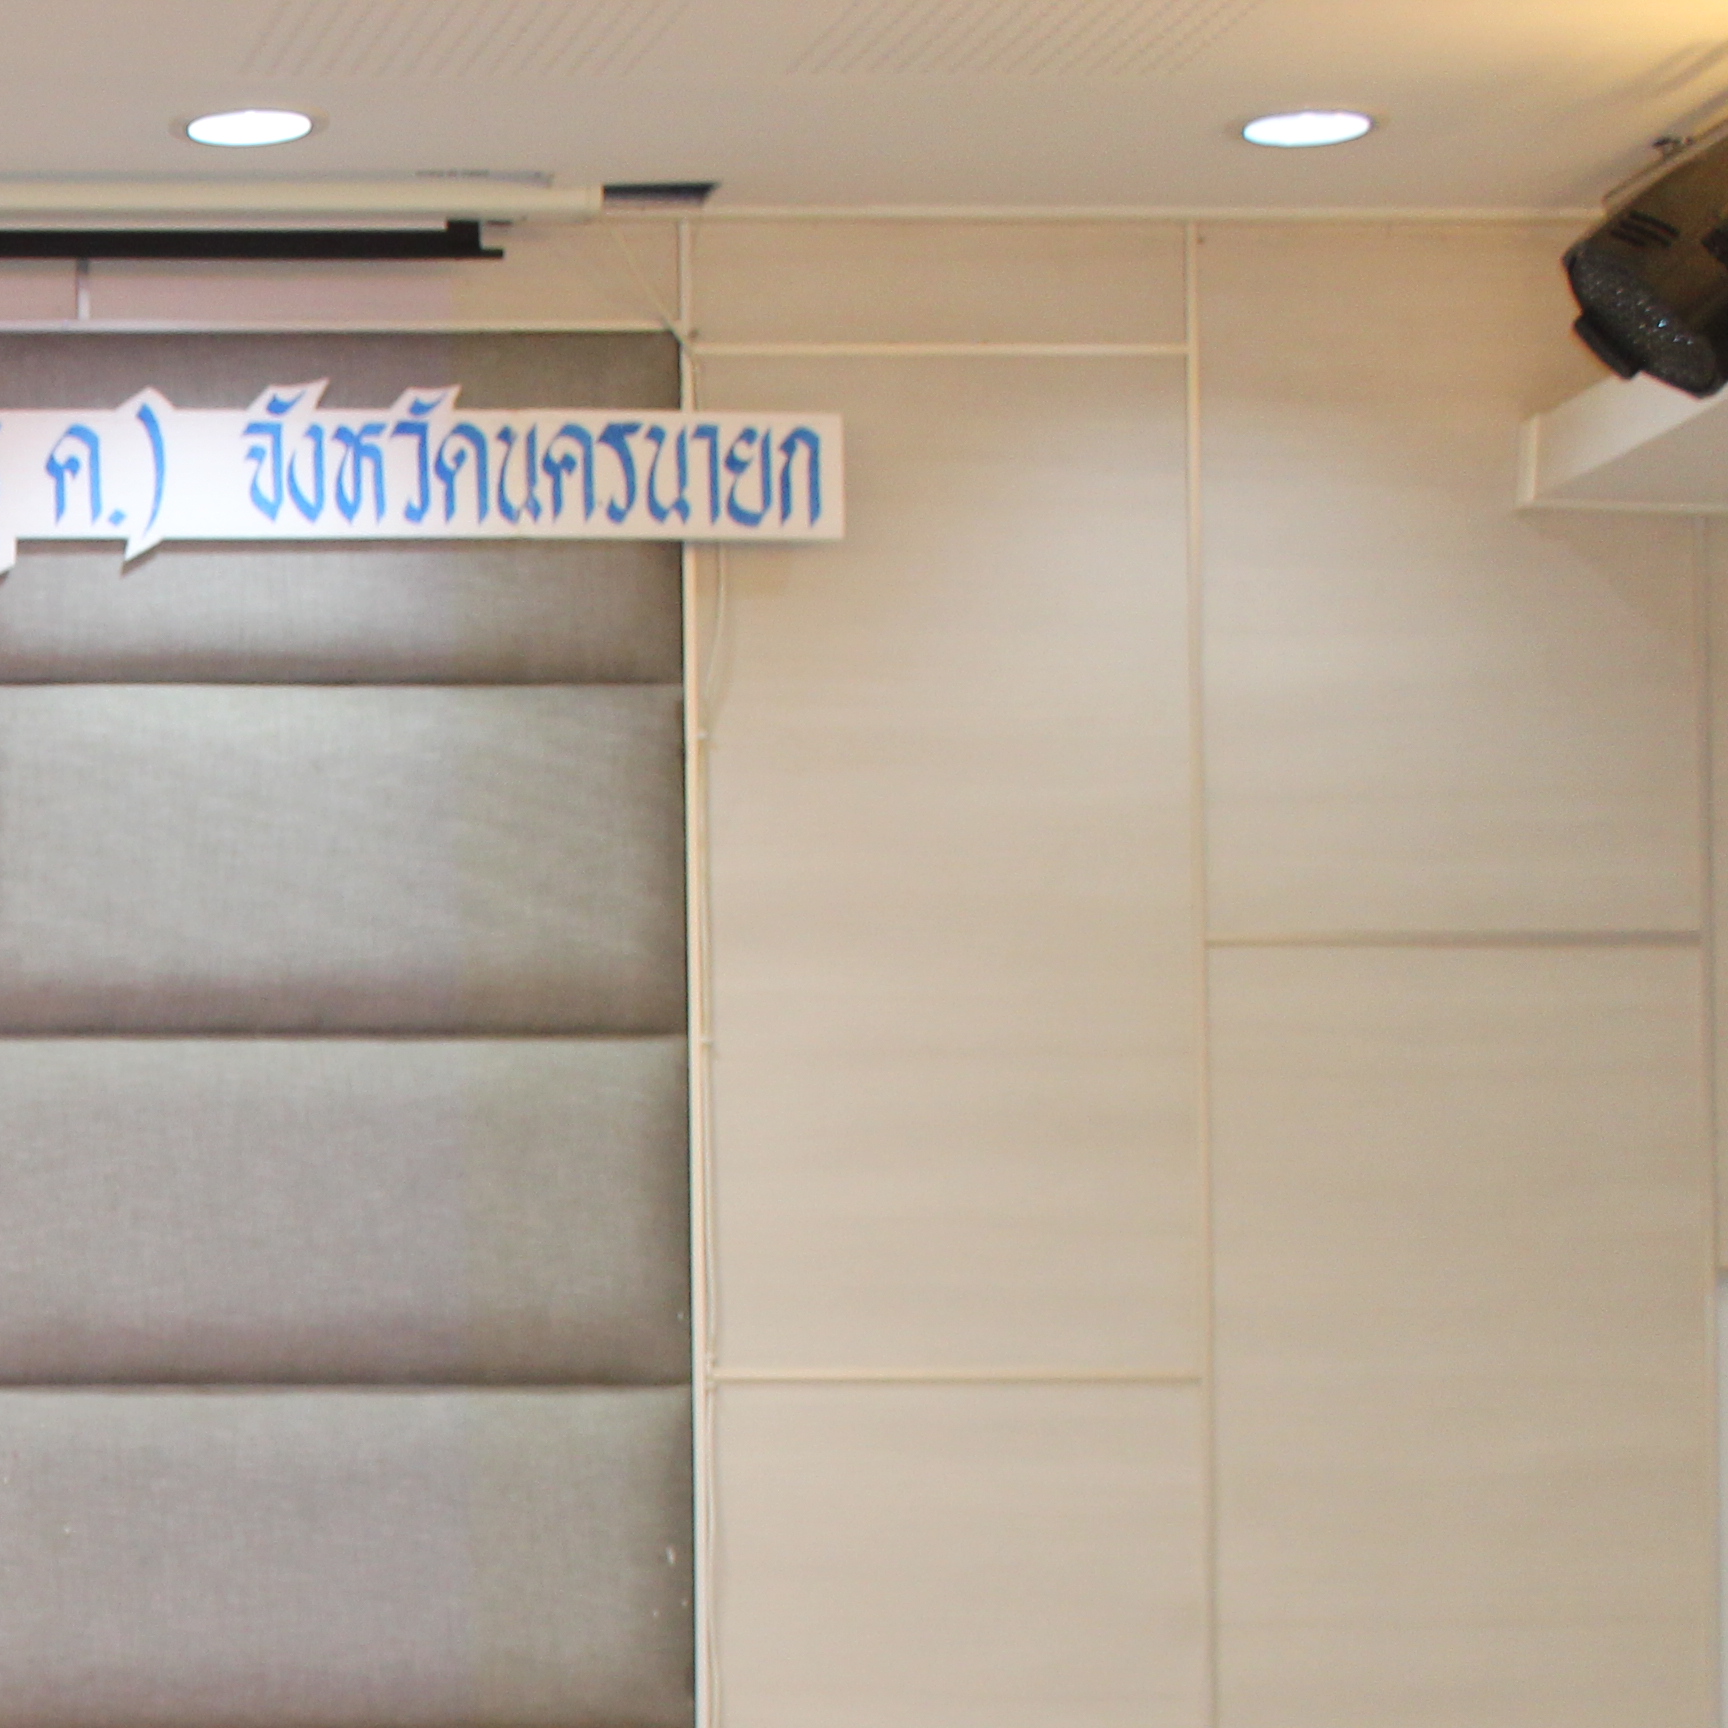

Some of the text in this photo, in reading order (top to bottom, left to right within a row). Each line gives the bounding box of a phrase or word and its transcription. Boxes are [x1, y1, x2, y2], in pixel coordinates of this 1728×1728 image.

[243, 389, 822, 527] จังหวัดนครนายก
